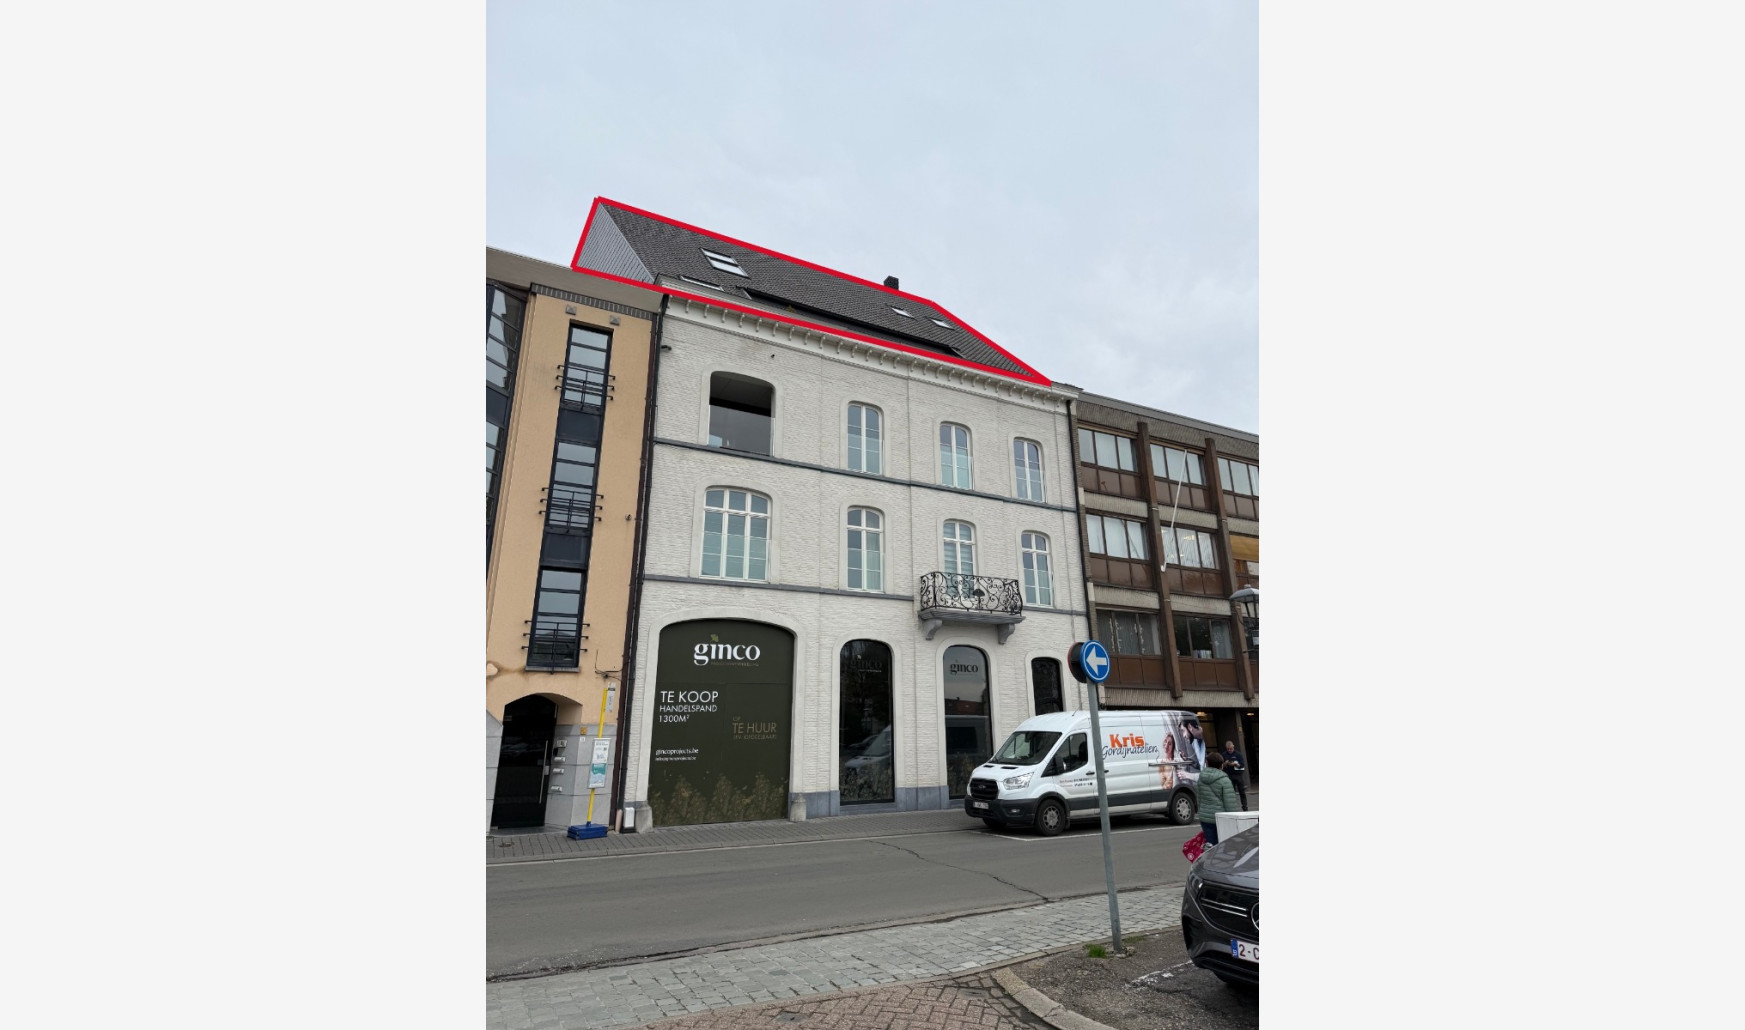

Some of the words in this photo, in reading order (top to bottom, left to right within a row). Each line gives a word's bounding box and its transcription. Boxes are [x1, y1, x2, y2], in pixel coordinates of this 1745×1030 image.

[693, 642, 761, 666] ginco
[950, 663, 979, 675] ginco
[660, 690, 675, 703] TE
[678, 690, 719, 703] KOOP
[659, 704, 718, 712] HANDELSPAND
[732, 722, 744, 734] TE
[746, 722, 777, 734] HUUR
[1109, 733, 1145, 748] Kris
